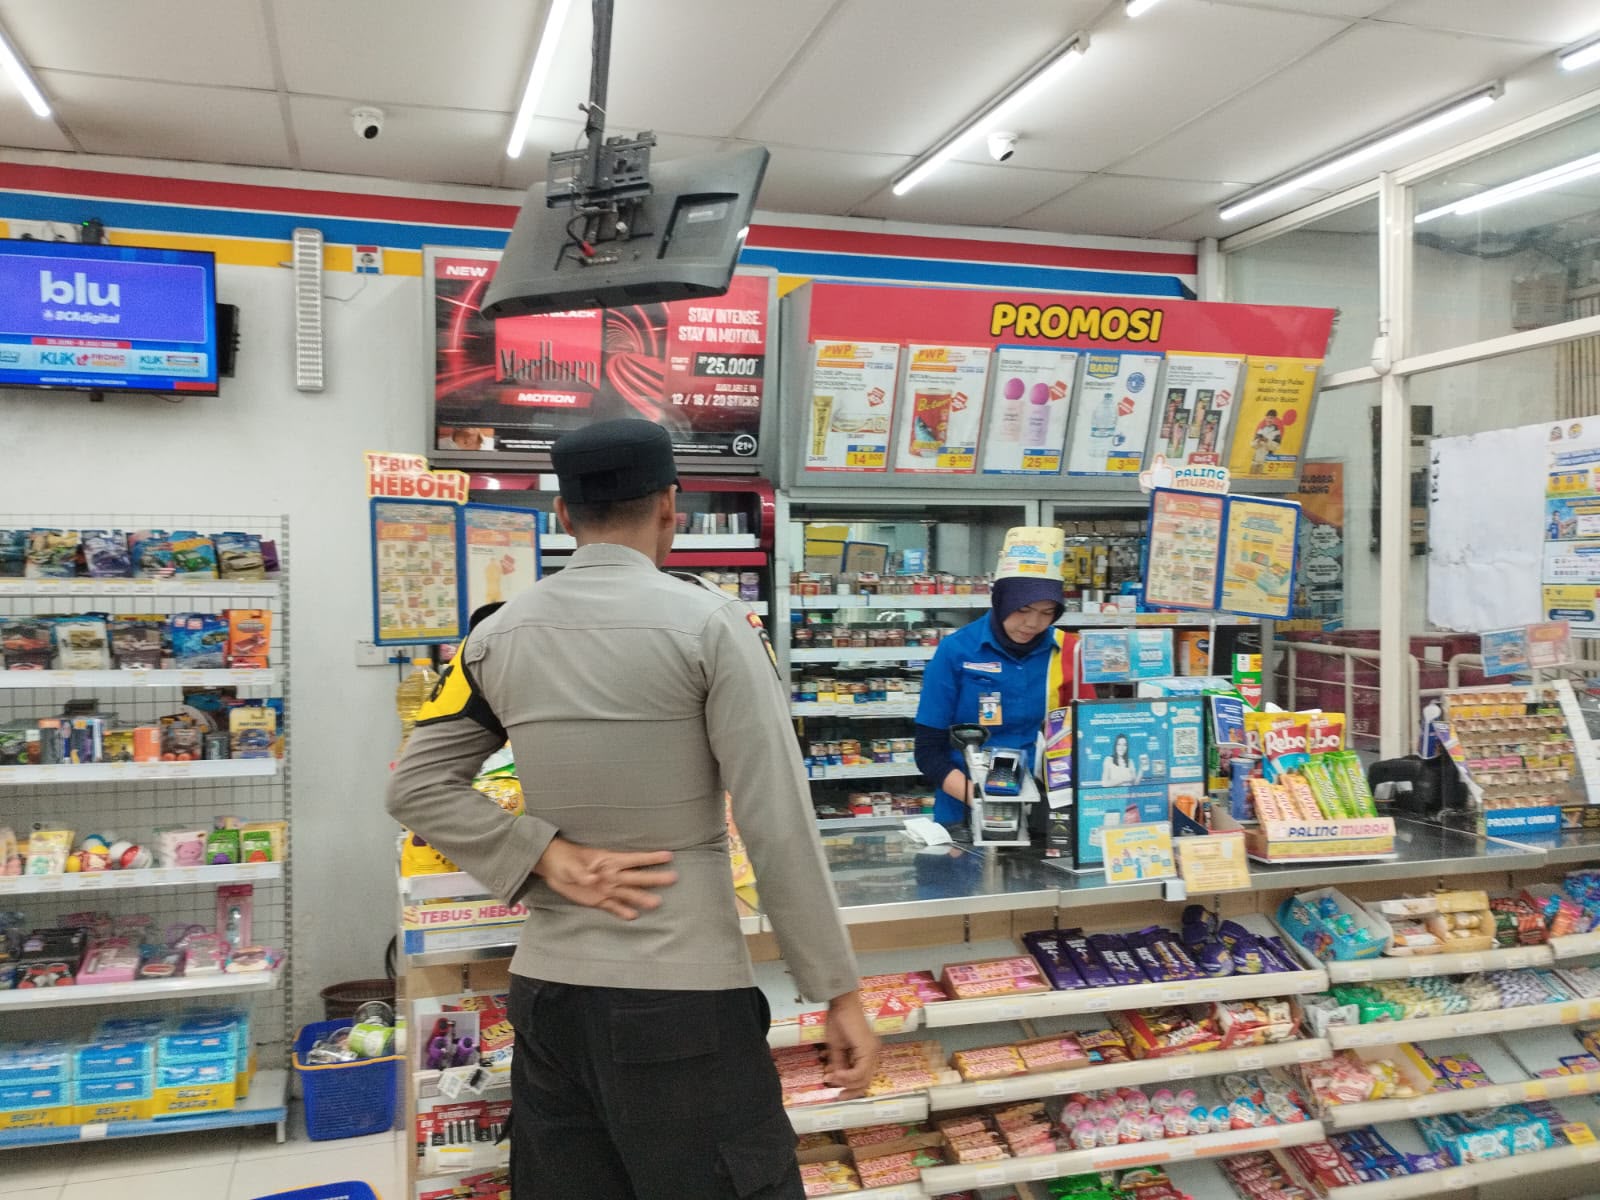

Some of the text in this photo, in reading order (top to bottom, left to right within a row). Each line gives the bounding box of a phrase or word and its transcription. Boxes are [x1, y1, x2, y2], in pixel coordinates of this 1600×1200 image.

[446, 265, 488, 277] NEW
[40, 270, 121, 308] blu
[688, 307, 715, 323] STAY
[990, 301, 1164, 344] PROMOSI
[678, 326, 705, 342] STAY
[706, 327, 718, 343] IN
[500, 339, 598, 385] Marlboro
[1089, 364, 1117, 373] BARU
[517, 392, 577, 404] MOTION
[735, 441, 754, 451] 21+
[367, 454, 424, 471] TEBUS
[1175, 468, 1226, 480] PALING
[370, 473, 465, 501] HEBOH!
[1176, 478, 1226, 491] MURAH
[1288, 823, 1390, 838] PALING MURAH
[420, 909, 473, 924] TEBUS
